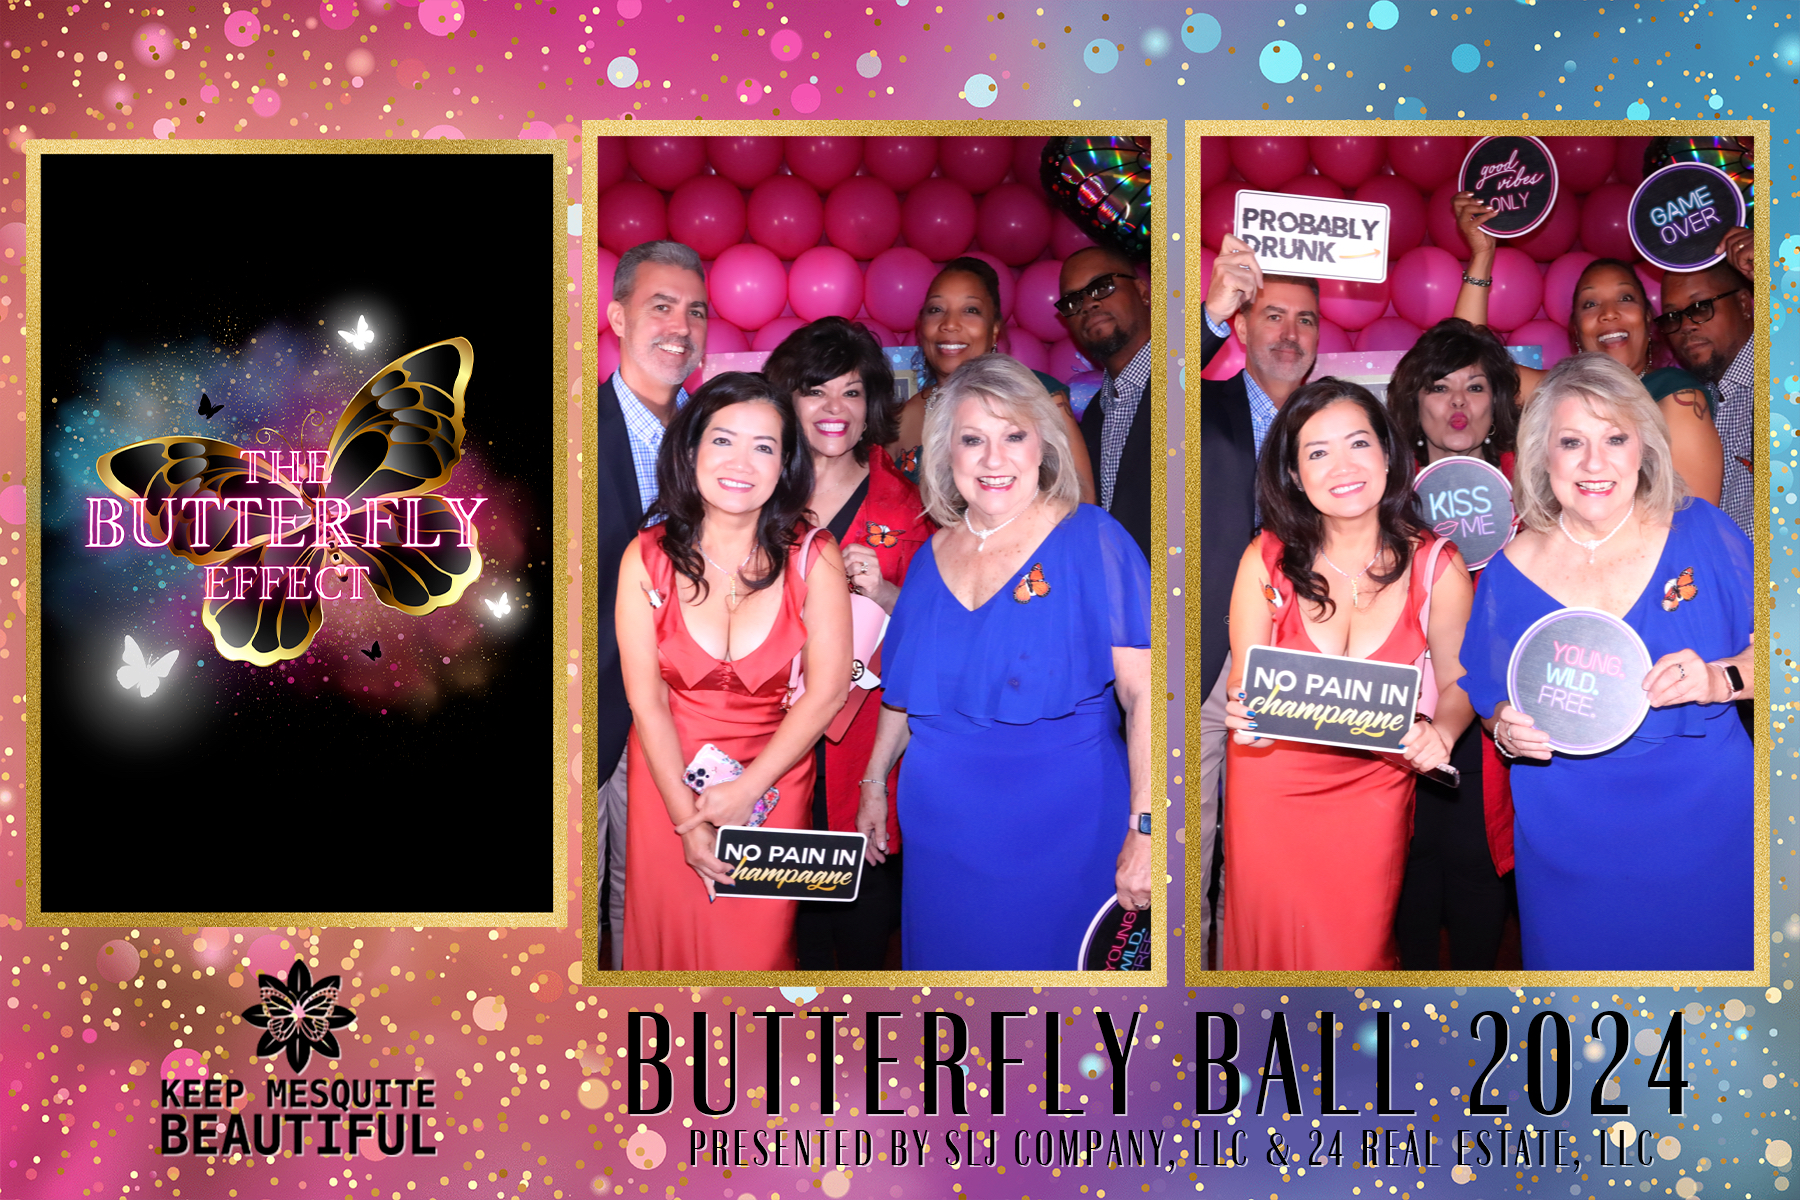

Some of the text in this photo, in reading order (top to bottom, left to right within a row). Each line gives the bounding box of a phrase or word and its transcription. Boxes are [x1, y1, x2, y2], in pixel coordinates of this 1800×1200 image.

[1475, 149, 1520, 190] good
[1497, 165, 1545, 191] vibes
[1489, 191, 1530, 212] ONLY
[1650, 185, 1715, 227] GAME
[1242, 208, 1380, 241] PROBABLY
[1660, 206, 1721, 245] OVER
[1241, 234, 1337, 263] DRUNK
[1429, 485, 1492, 521] KISS
[1460, 514, 1496, 538] ME
[1553, 640, 1627, 680] YOUNG.
[1253, 666, 1409, 707] NO PAIN IN
[1546, 662, 1600, 696] WILD.
[1248, 684, 1405, 738] champagne
[1538, 684, 1597, 719] FREE.
[724, 843, 857, 866] NO PAIN IN
[730, 855, 853, 891] hampagne
[1102, 910, 1139, 971] YOUNG
